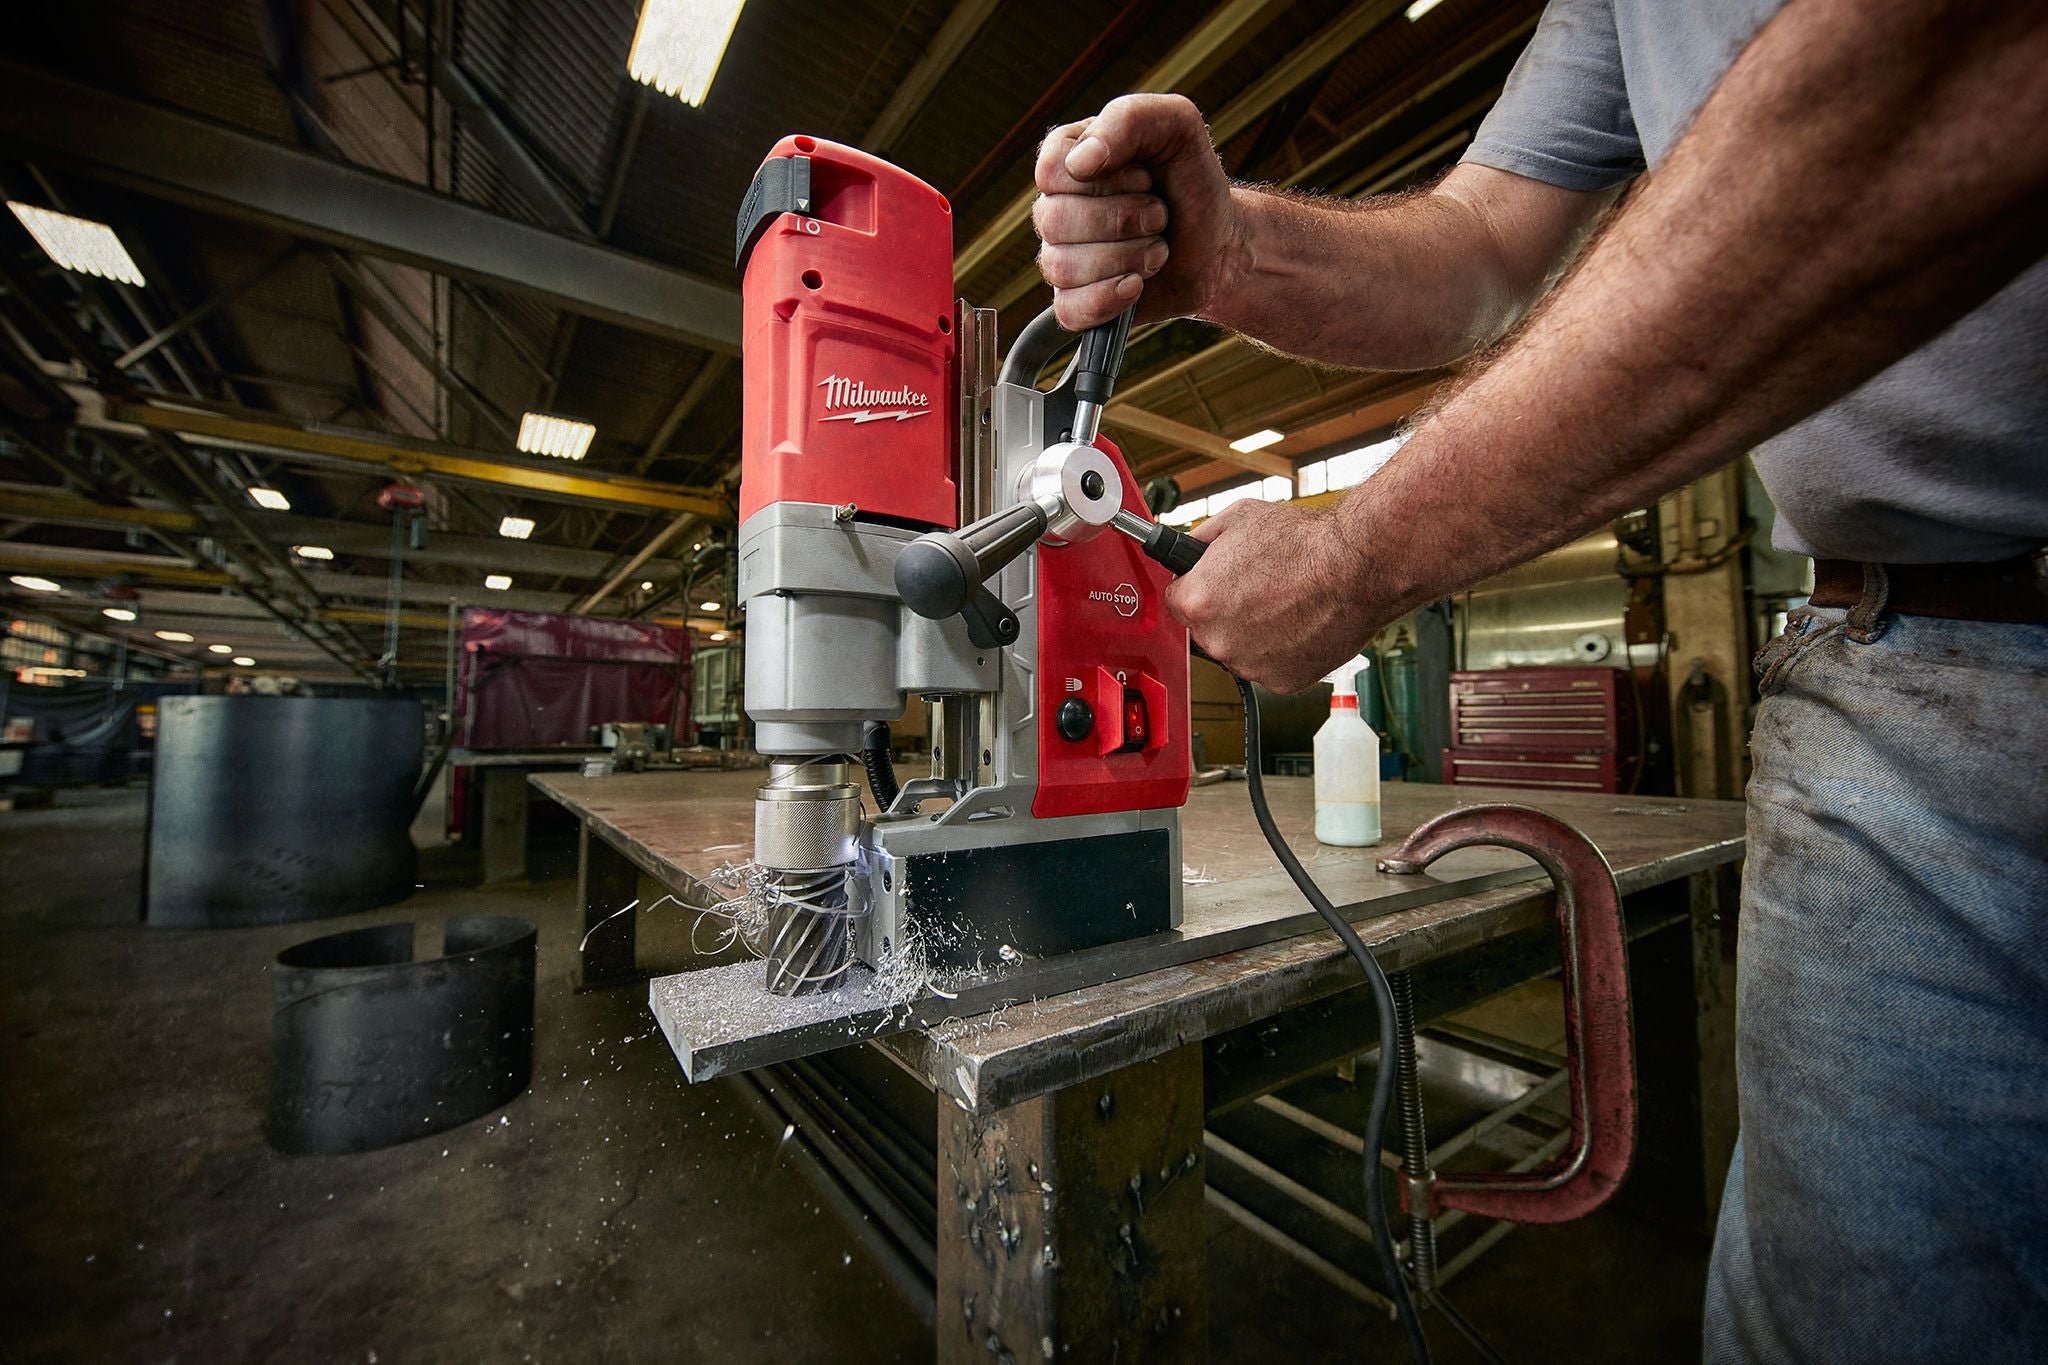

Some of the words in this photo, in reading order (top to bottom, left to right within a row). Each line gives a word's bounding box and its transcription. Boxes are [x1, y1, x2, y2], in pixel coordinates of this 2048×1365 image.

[817, 373, 930, 410] Milwaukee
[1088, 590, 1113, 602] AUTO
[1113, 593, 1136, 605] STOP
